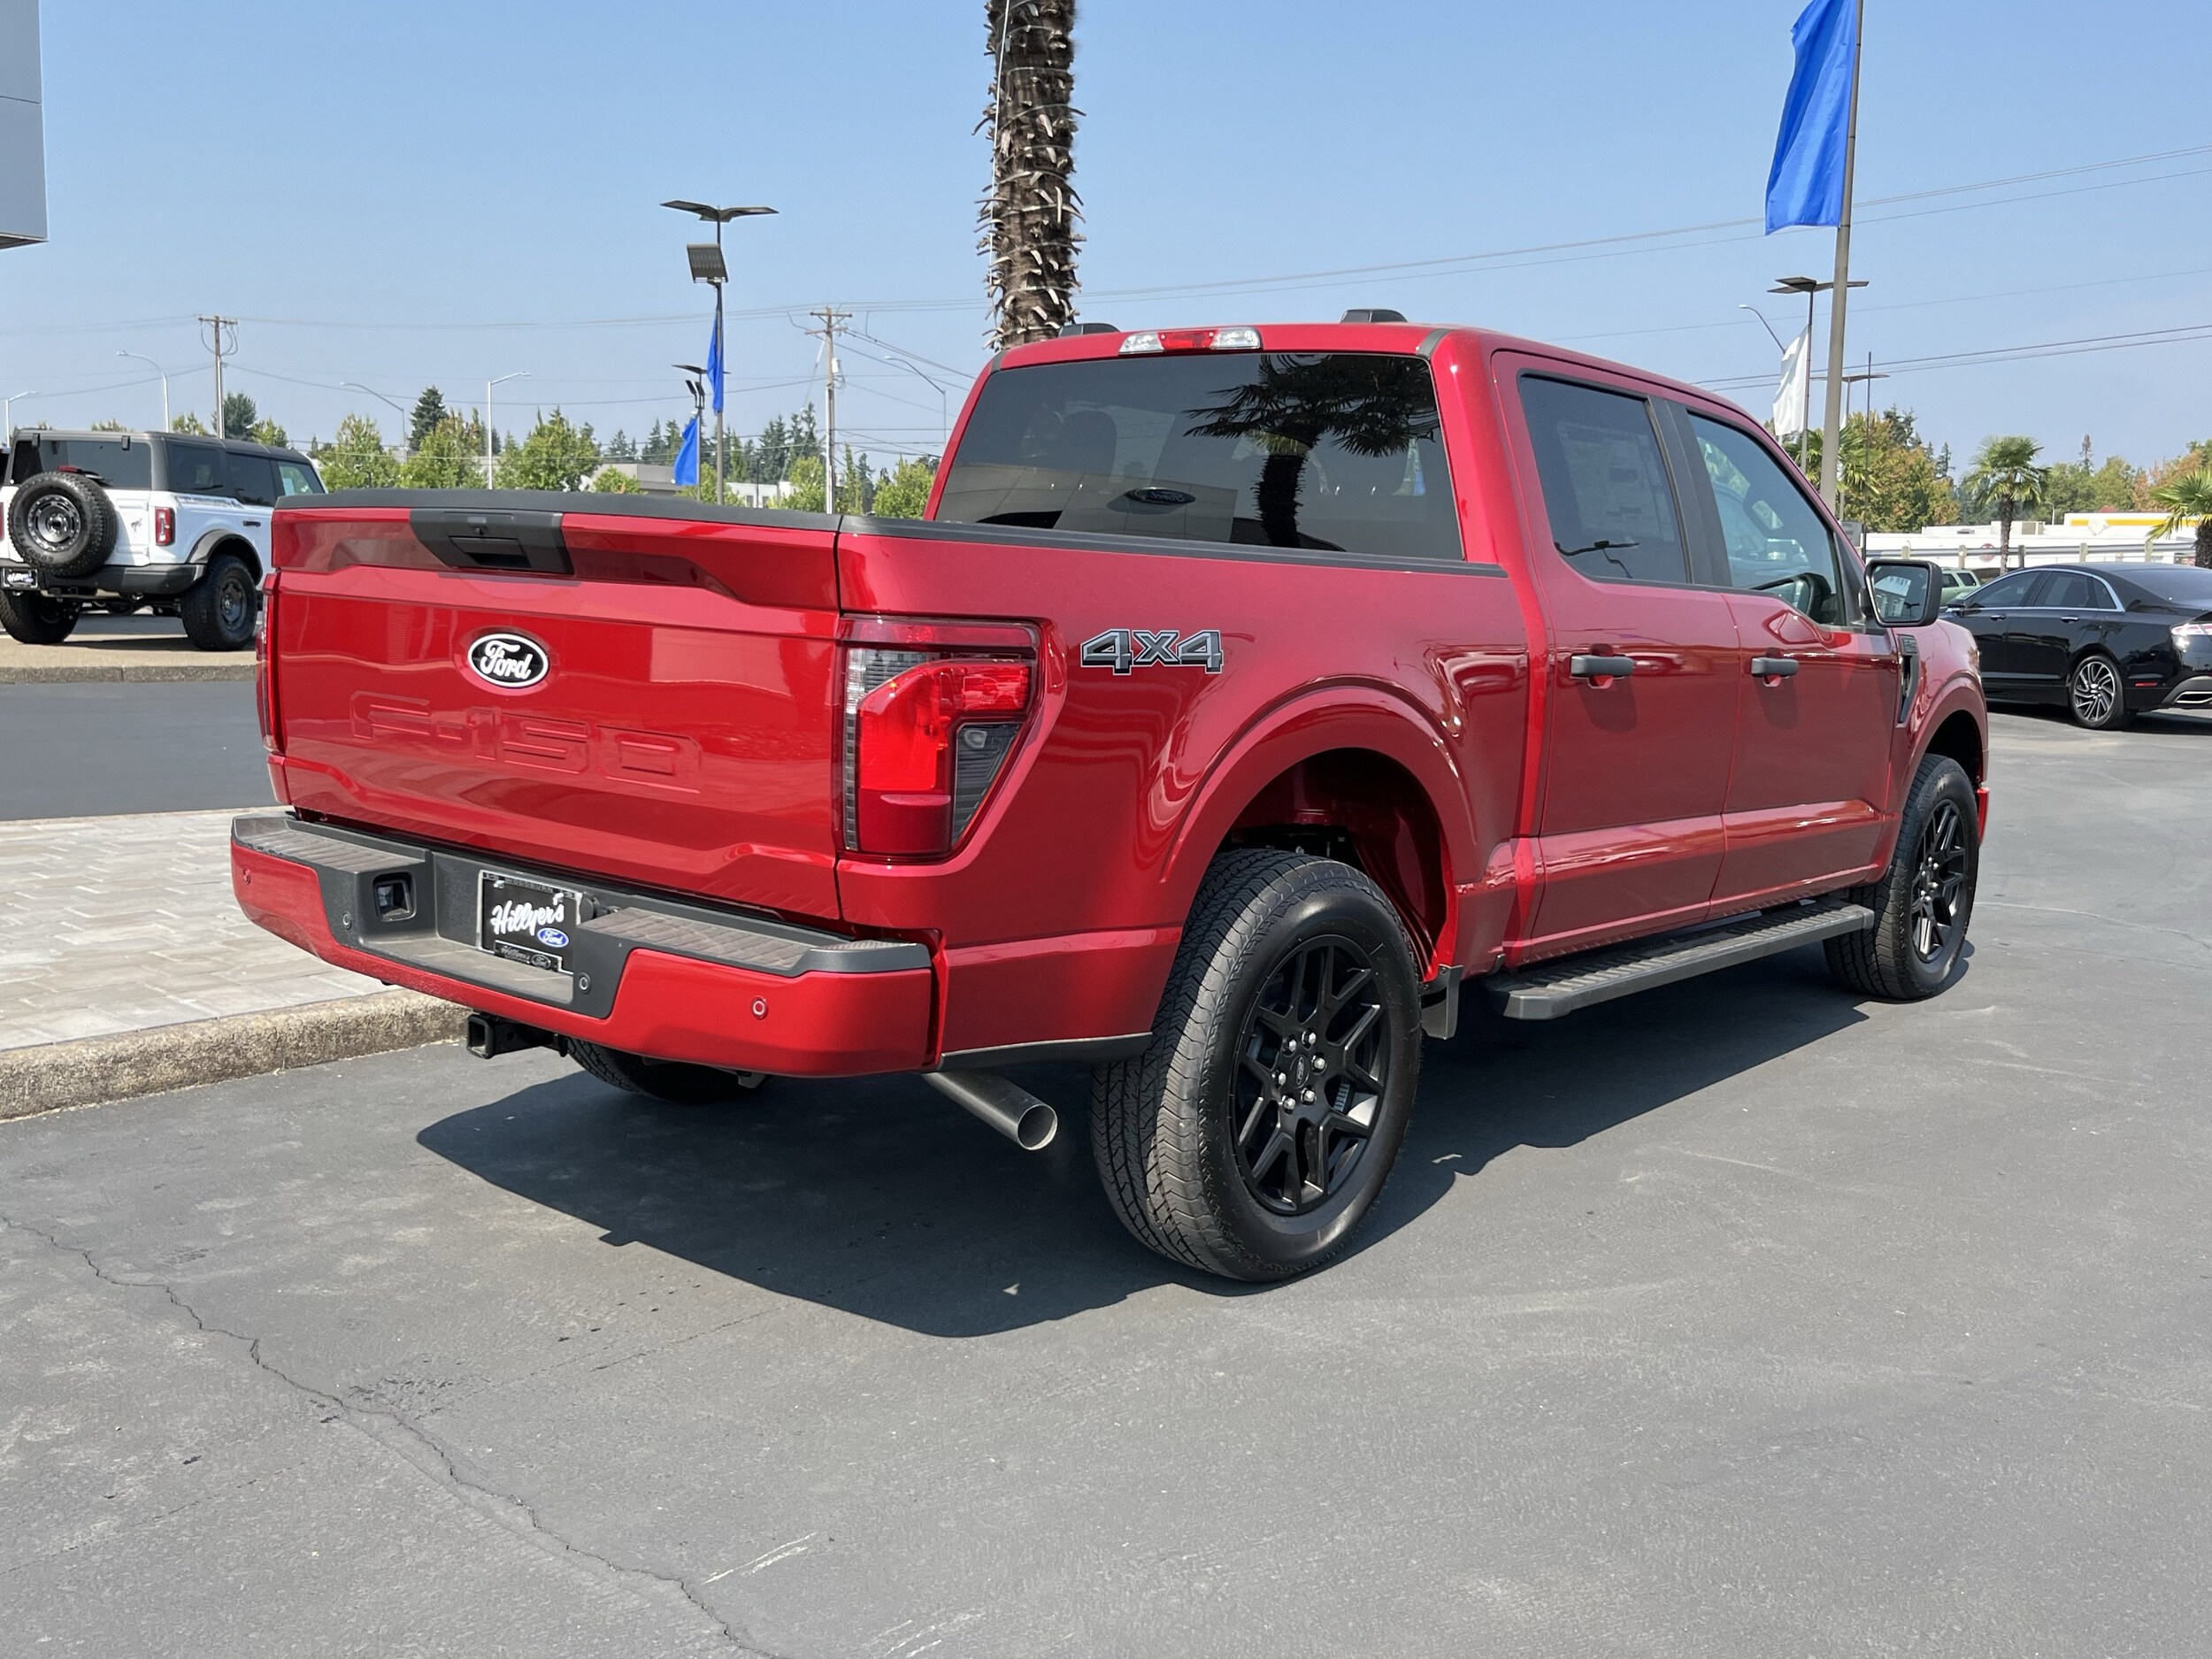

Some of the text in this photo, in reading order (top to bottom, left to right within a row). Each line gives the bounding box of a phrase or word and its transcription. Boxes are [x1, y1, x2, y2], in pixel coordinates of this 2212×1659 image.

[479, 640, 534, 680] Ford
[350, 690, 703, 795] F-150
[490, 898, 565, 936] Hillyer's
[541, 929, 565, 946] Ford
